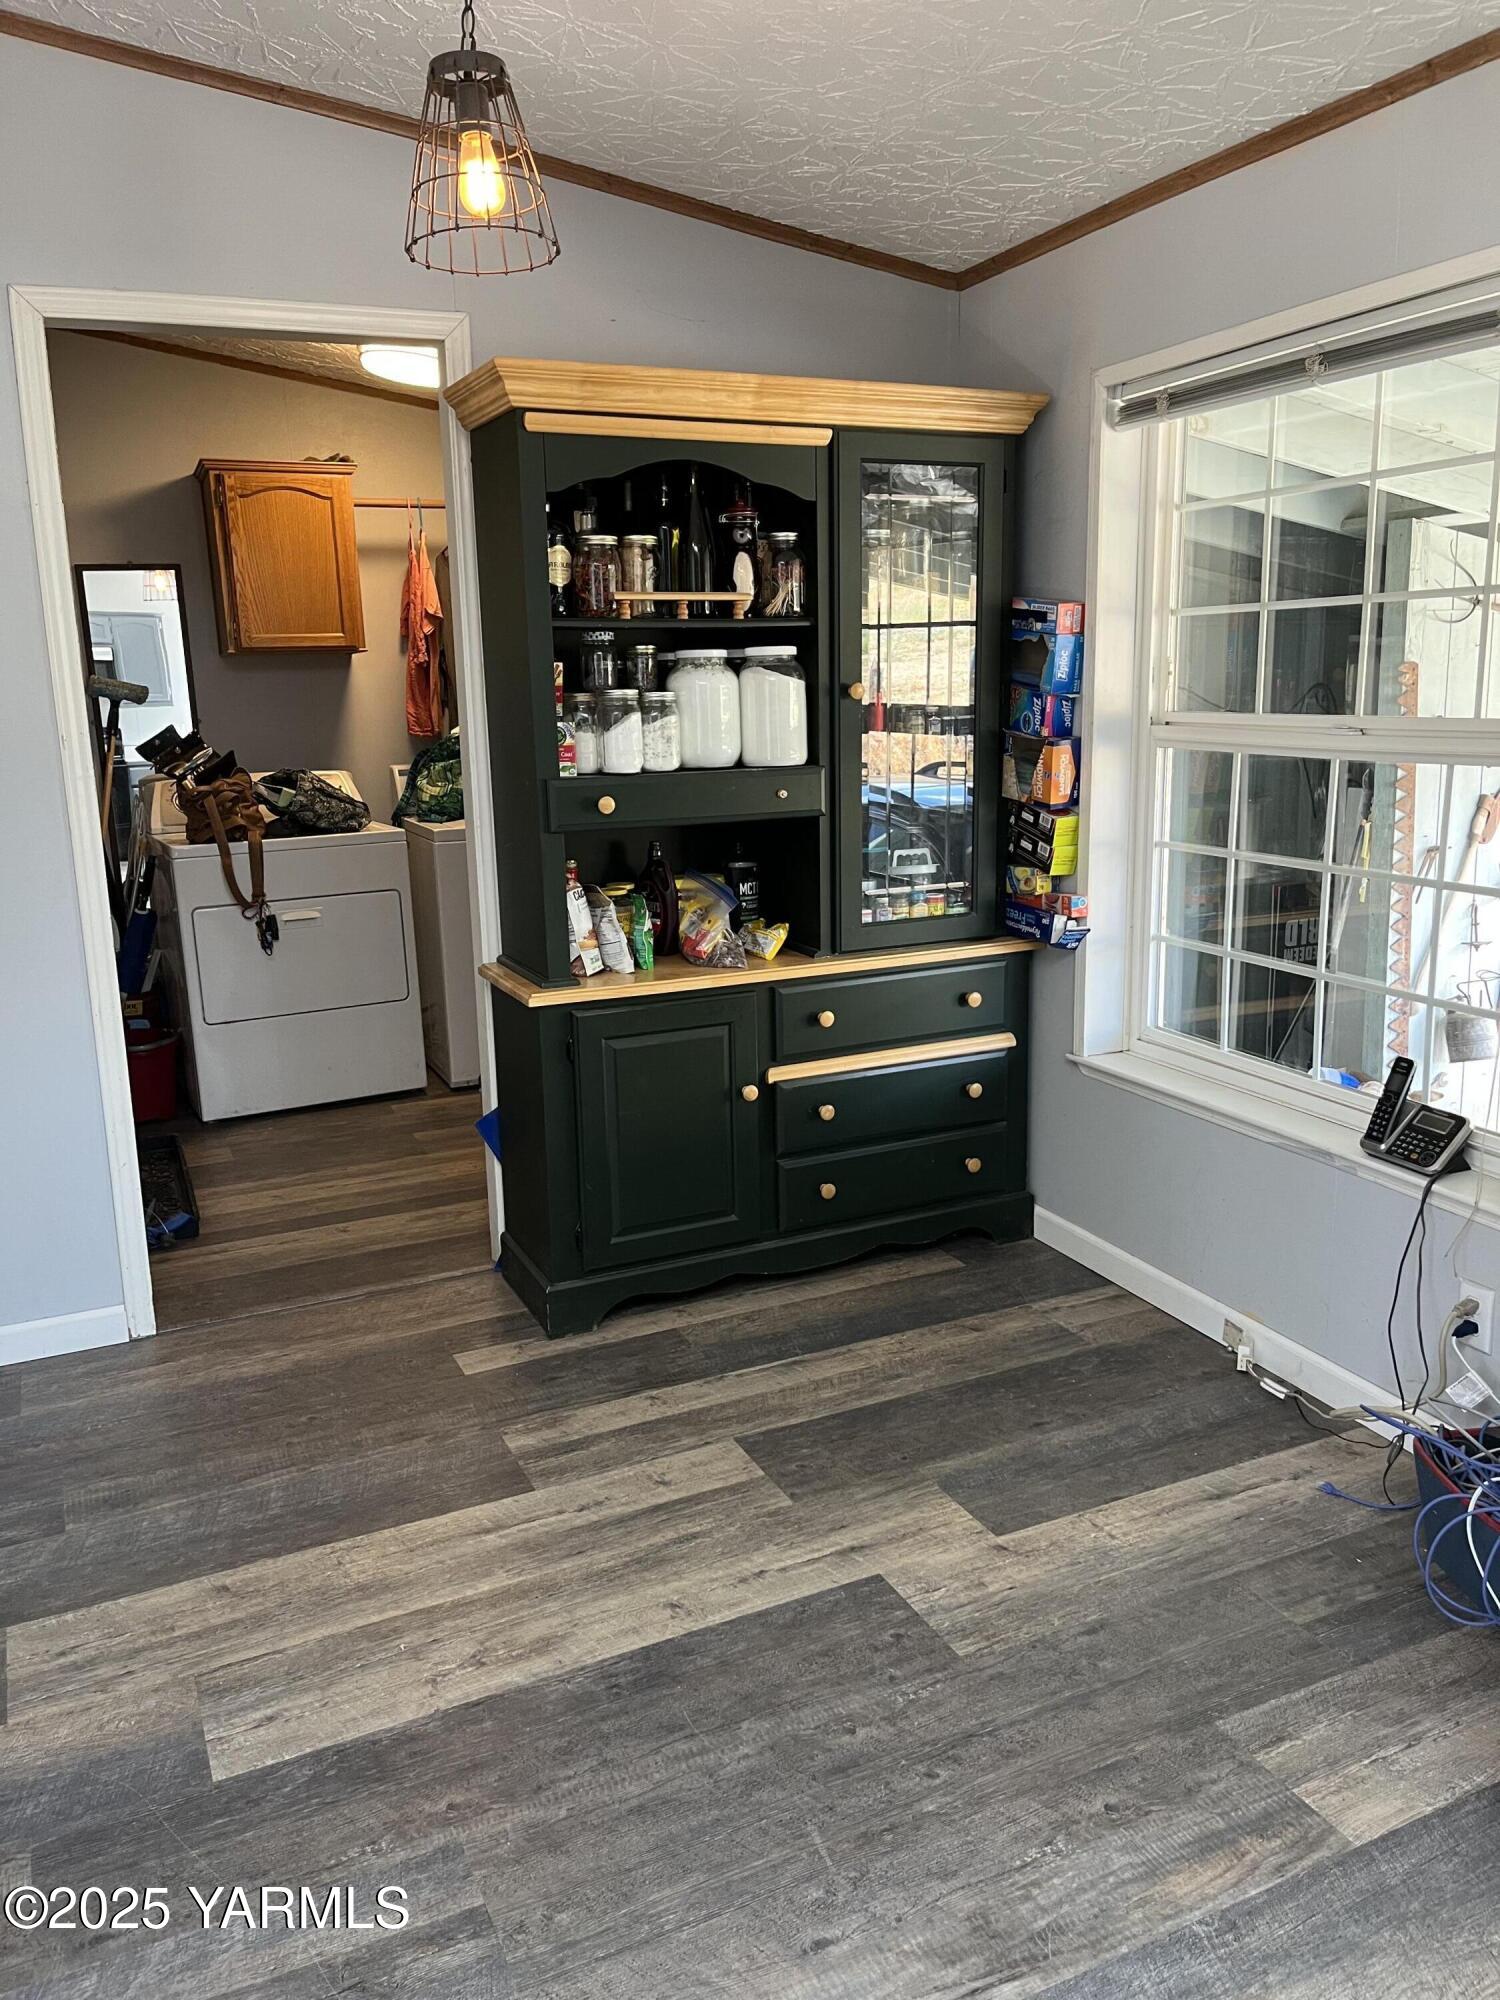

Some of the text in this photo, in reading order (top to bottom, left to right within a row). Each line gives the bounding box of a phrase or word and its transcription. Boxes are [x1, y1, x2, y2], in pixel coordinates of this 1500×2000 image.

[1057, 650, 1069, 680] Ziploc
[1033, 697, 1042, 732] Ziploc
[1062, 700, 1072, 728] Ziploc
[740, 882, 756, 896] MCT
[1285, 919, 1318, 946] RLD
[1284, 947, 1317, 961] EDEEM
